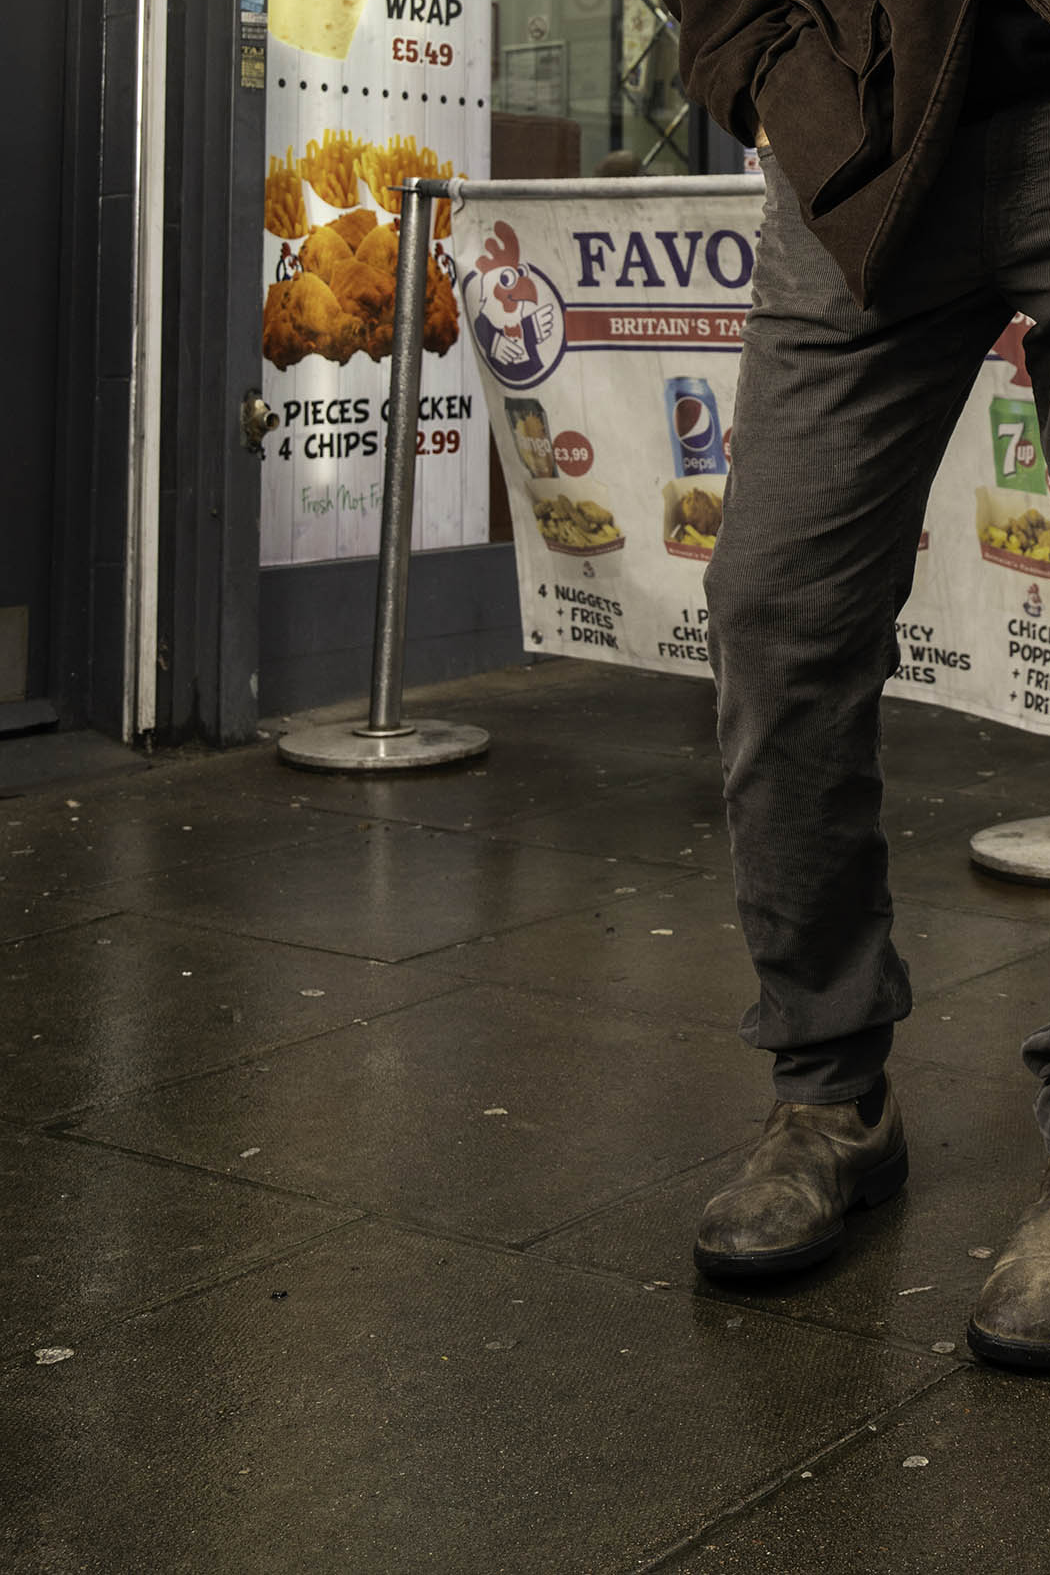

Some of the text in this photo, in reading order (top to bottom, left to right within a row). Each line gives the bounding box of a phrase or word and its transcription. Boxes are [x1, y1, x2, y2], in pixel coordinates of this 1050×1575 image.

[392, 36, 454, 67] £5.49
[573, 229, 761, 289] FAVO
[609, 317, 711, 336] BRITAIN'S
[283, 398, 370, 427] PIECES
[304, 430, 378, 459] CHIPS
[682, 455, 717, 472] pepsi
[538, 583, 623, 617] 4 NUGGETS
